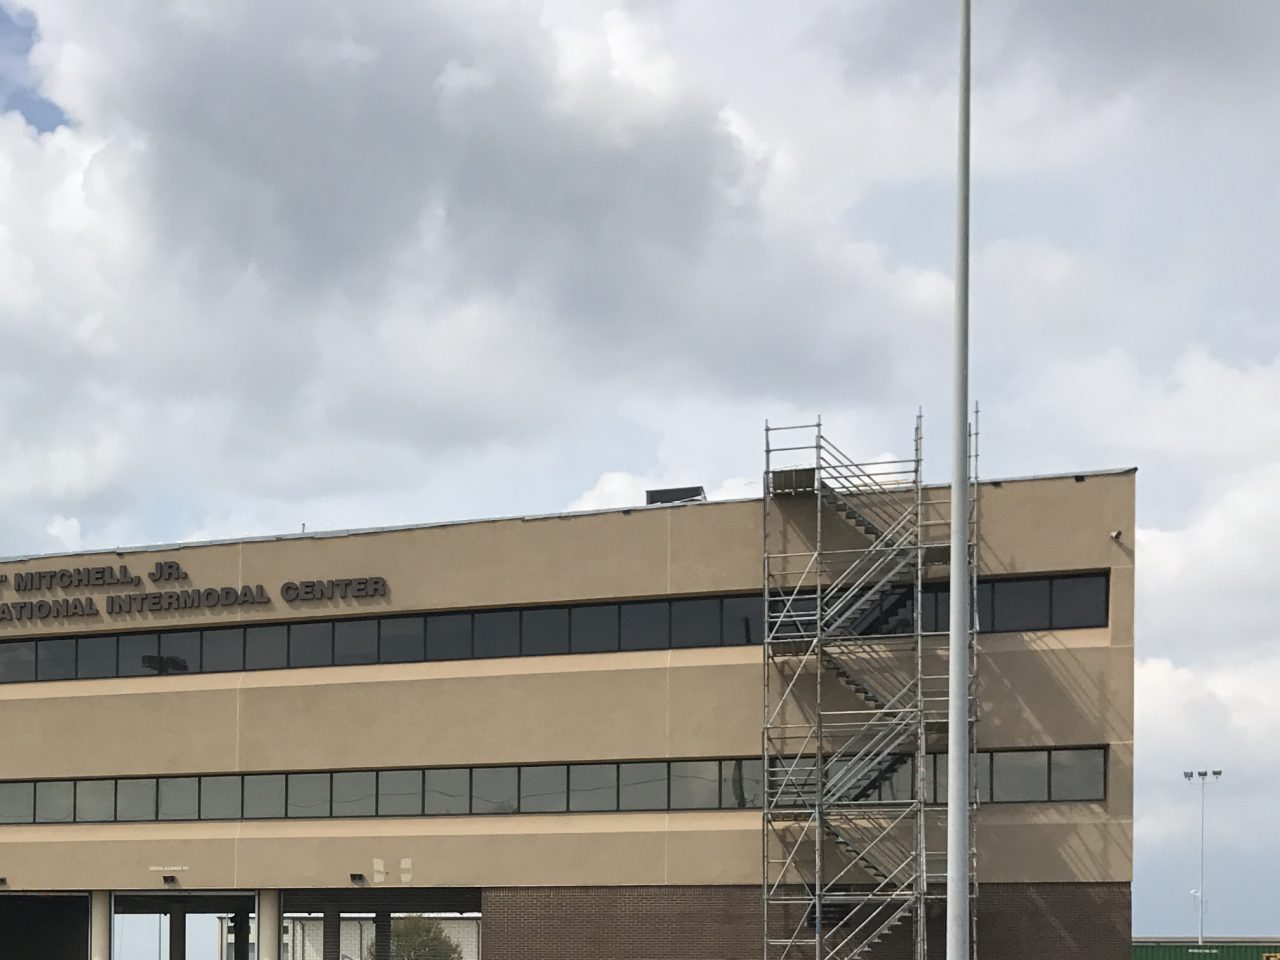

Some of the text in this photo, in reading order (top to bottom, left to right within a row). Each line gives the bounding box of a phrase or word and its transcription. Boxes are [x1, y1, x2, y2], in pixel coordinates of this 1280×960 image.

[14, 565, 140, 592] MITCHELL,
[148, 561, 189, 582] JR.
[106, 585, 271, 615] INTERMODAL
[280, 577, 386, 602] CENTER
